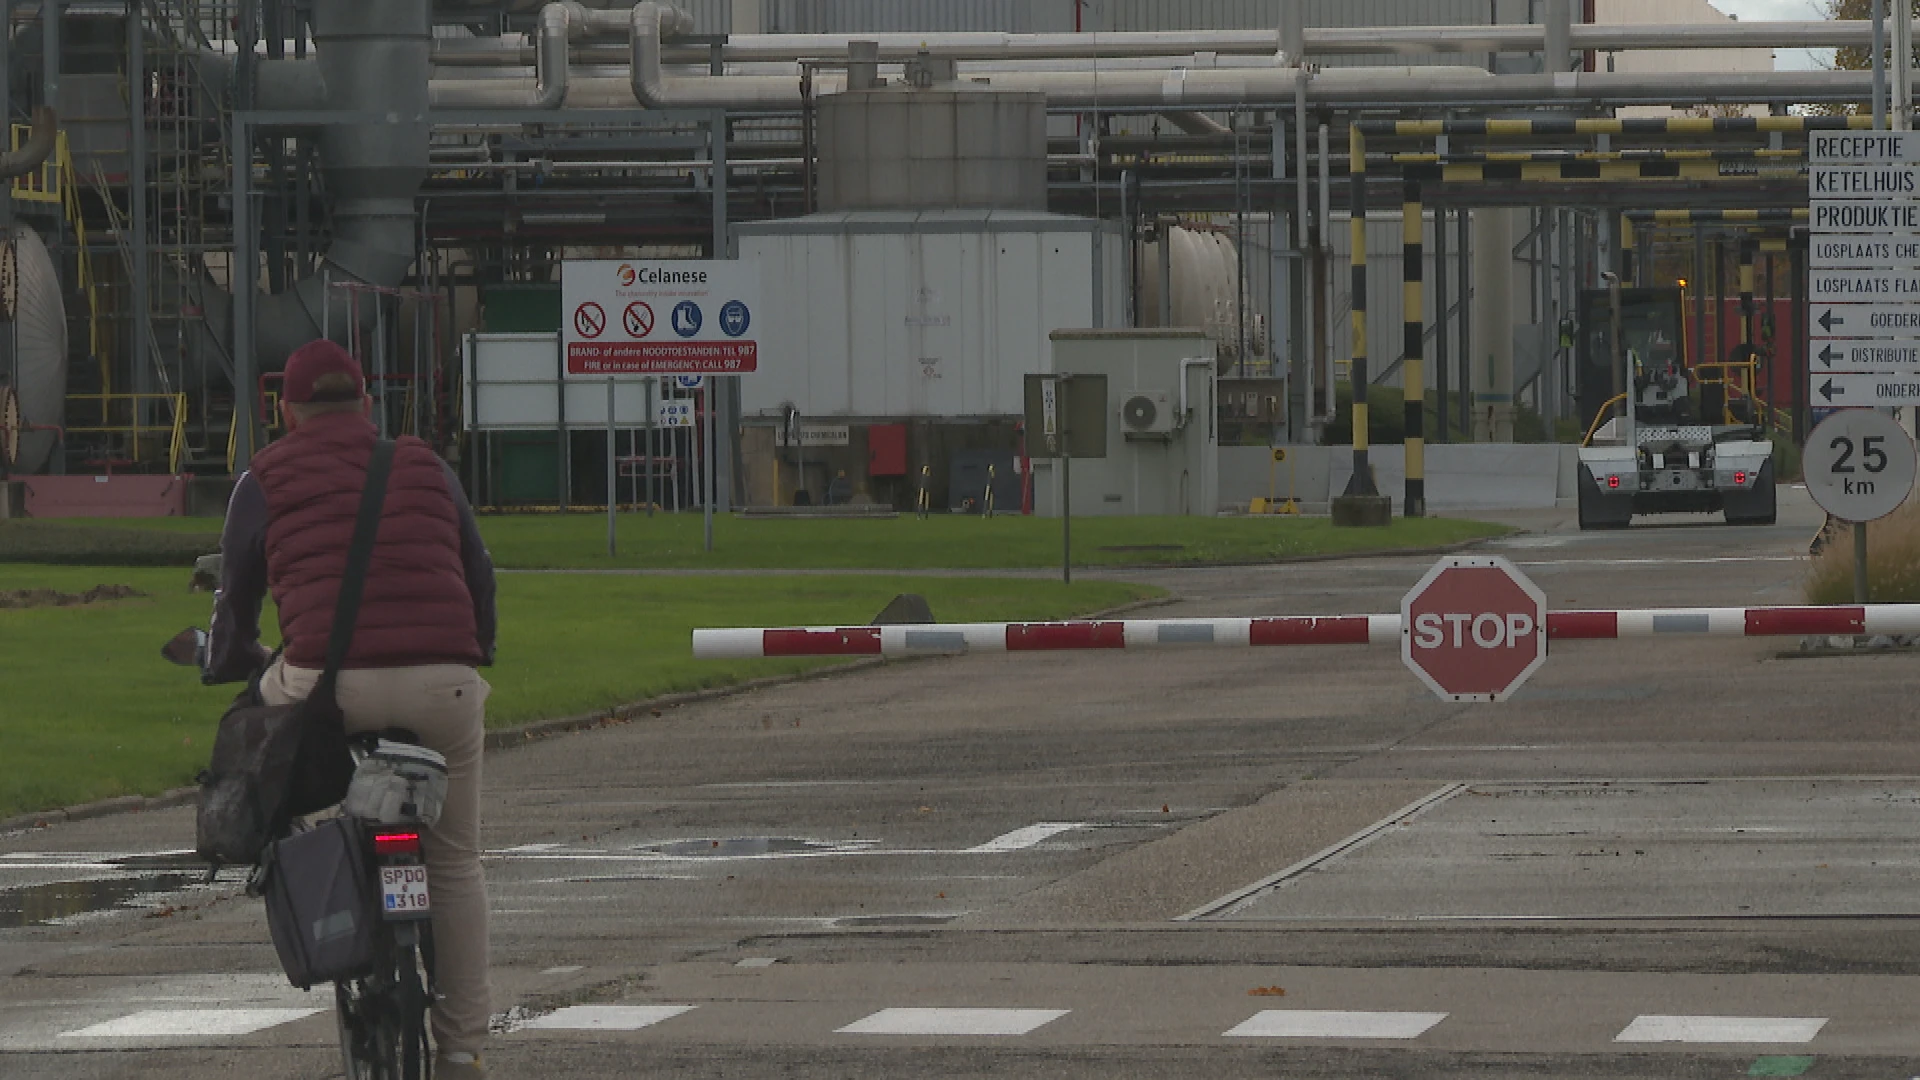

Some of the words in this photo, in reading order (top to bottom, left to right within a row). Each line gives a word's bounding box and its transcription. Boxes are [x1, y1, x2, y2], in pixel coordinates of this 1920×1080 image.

[1816, 137, 1903, 159] RECEPTIE
[1816, 171, 1915, 193] KETELHUIS
[1817, 206, 1918, 227] PRODUKTIE
[1817, 243, 1889, 259] LOSPLAATS
[1895, 243, 1920, 259] CHE
[638, 267, 708, 284] Celanese
[1816, 277, 1889, 293] LOSPLAATS
[1895, 277, 1920, 293] FLA
[1871, 312, 1920, 328] GOEDER
[603, 347, 612, 357] of
[613, 347, 640, 357] andere
[738, 345, 755, 356] 987
[1851, 347, 1918, 363] DISTRIBUTIE
[584, 361, 601, 370] FIRE
[602, 362, 611, 370] or
[612, 360, 621, 370] in
[622, 362, 640, 370] case
[641, 360, 650, 370] of
[702, 360, 723, 370] CALL
[724, 359, 741, 370] 987
[1829, 435, 1888, 474] 25
[1844, 477, 1875, 495] km
[1414, 612, 1534, 649] STOP
[396, 893, 427, 909] 318
